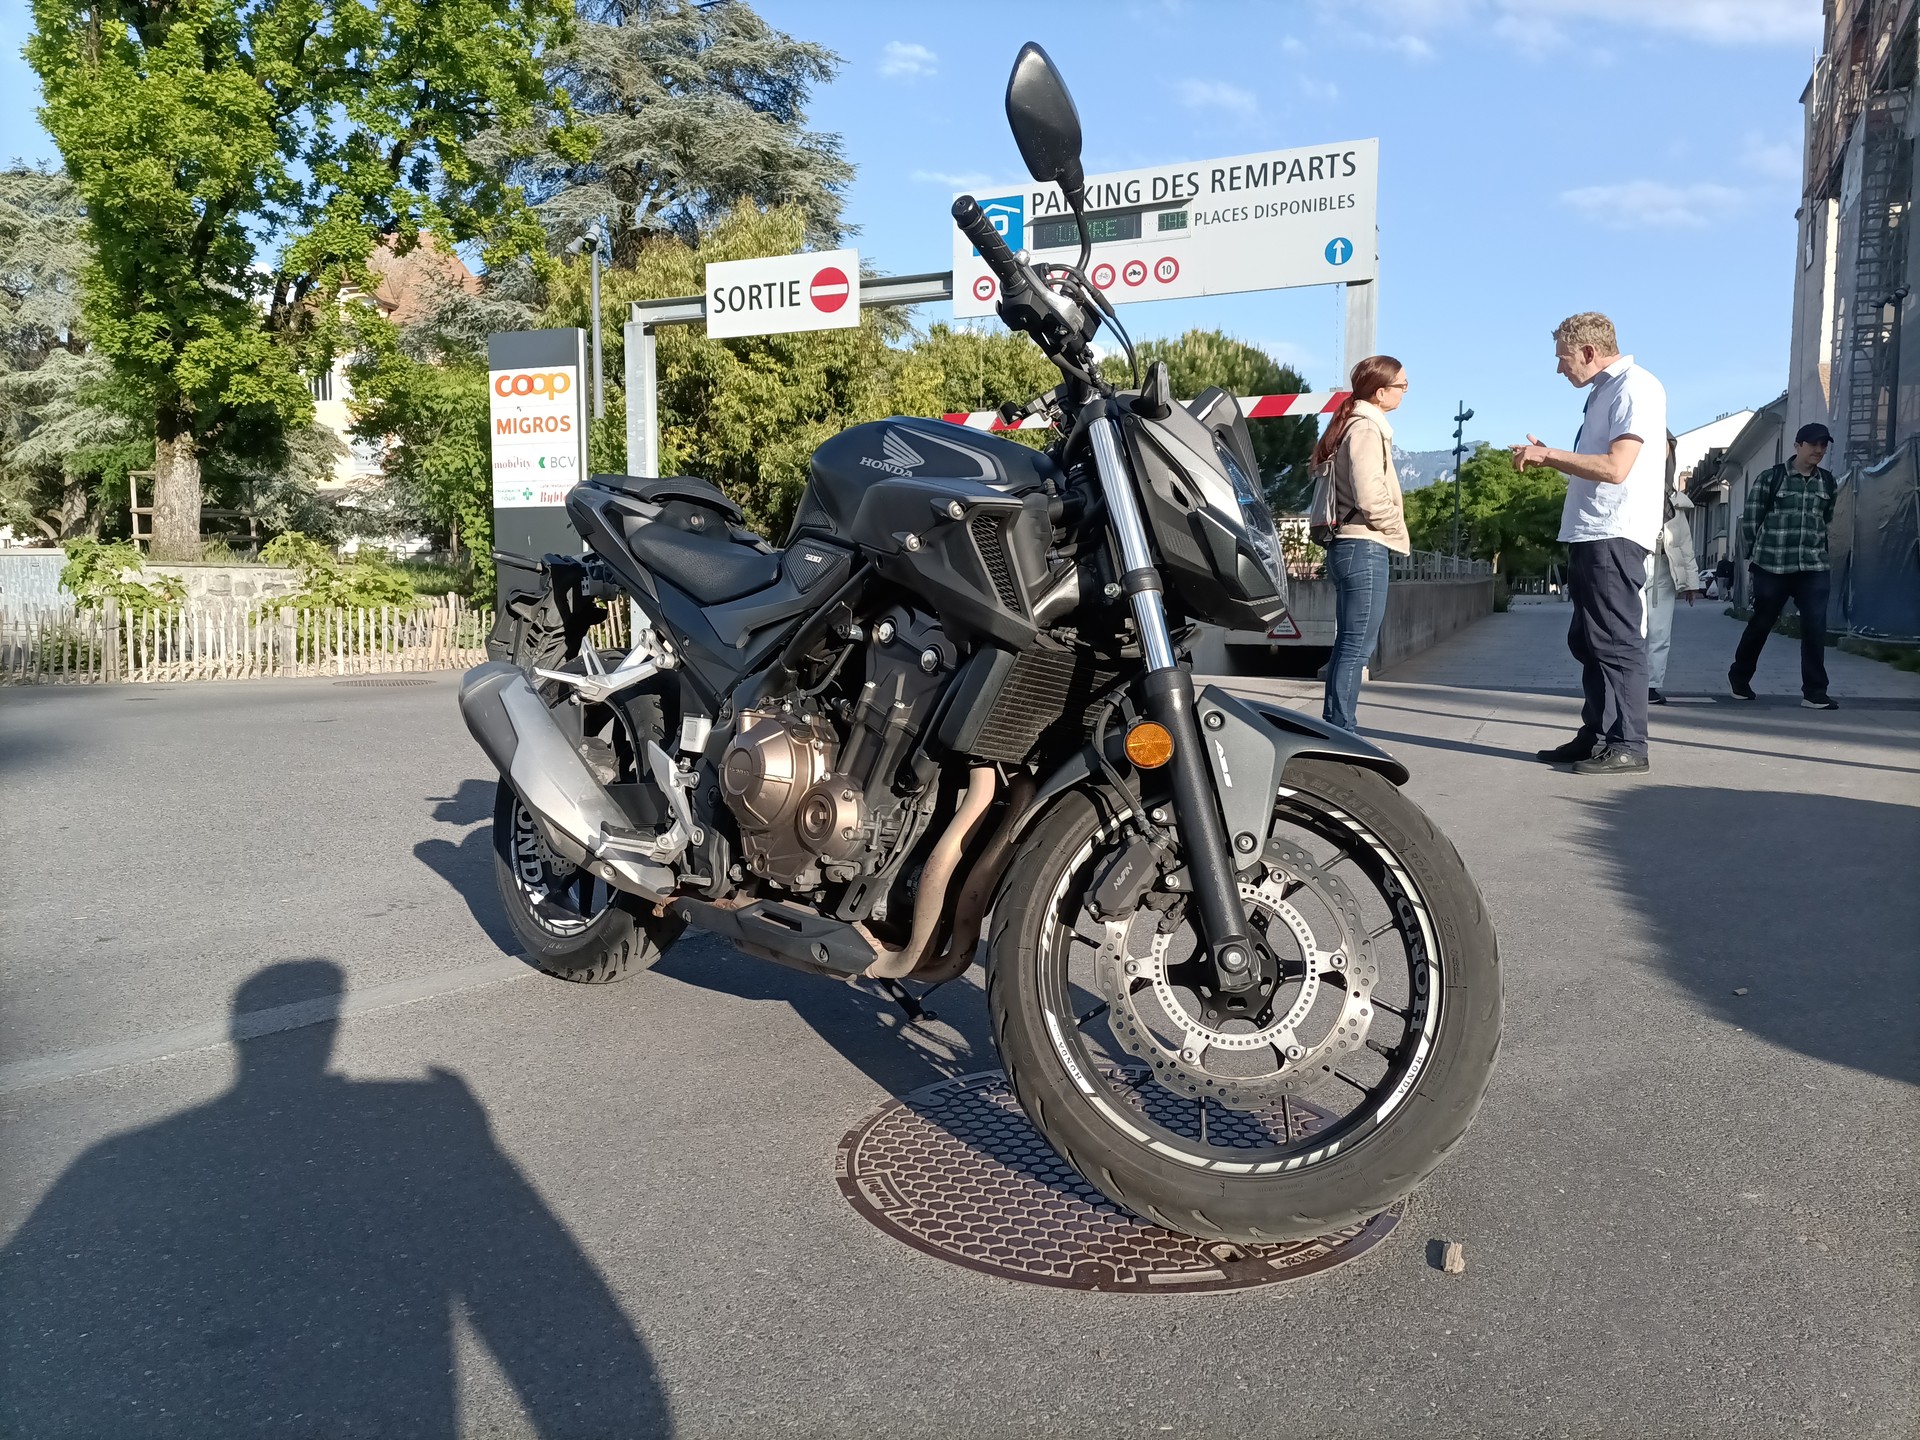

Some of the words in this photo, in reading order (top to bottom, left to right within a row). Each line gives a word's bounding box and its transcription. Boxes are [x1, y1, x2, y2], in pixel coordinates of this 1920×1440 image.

[1032, 180, 1141, 216] PAKING
[1152, 172, 1200, 201] DES
[1211, 151, 1357, 193] REMPARTS
[1194, 206, 1249, 226] PLACES
[1254, 193, 1355, 219] DISPONIBLES
[1162, 265, 1173, 275] 10
[713, 280, 801, 314] SORTIE
[495, 372, 571, 400] coop
[496, 415, 571, 435] MIGROS
[494, 456, 532, 470] mobility
[550, 456, 576, 468] BCV
[859, 456, 913, 477] HONDA
[1310, 778, 1404, 843] MICHELIN
[517, 805, 551, 905] ONDA
[1410, 851, 1434, 884] ROAD
[1382, 864, 1428, 1033] HONDA
[1057, 1041, 1082, 1080] HONDA
[1397, 1056, 1424, 1095] HONDA
